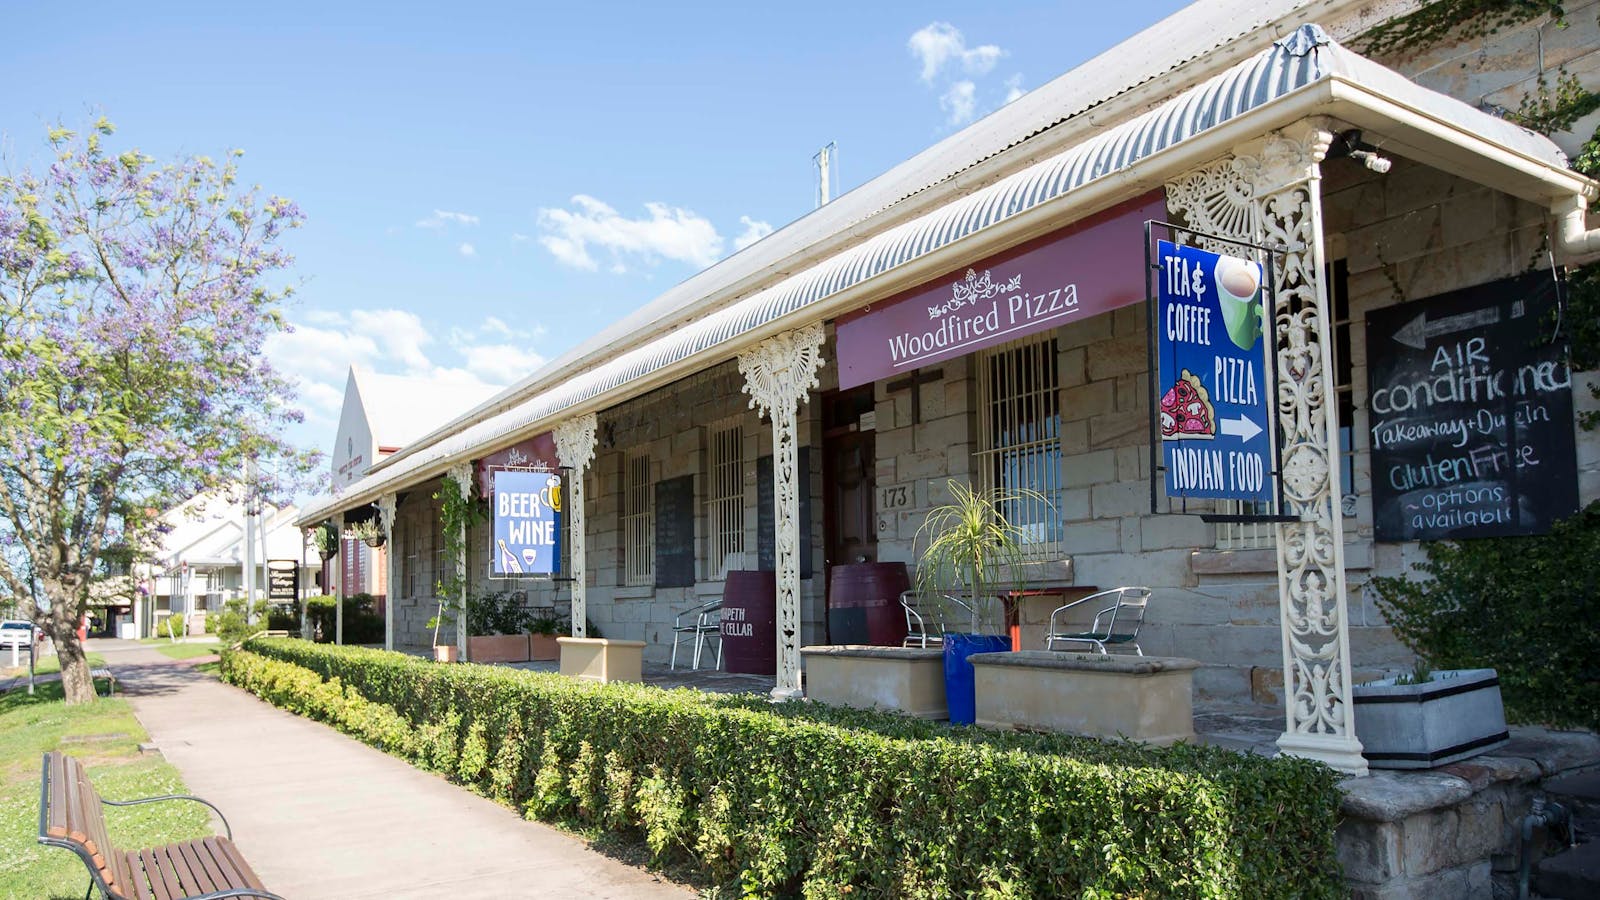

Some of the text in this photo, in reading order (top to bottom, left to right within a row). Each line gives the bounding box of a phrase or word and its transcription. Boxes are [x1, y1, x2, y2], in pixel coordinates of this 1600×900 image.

[889, 283, 1078, 361] Woodfired Pizza
[1166, 303, 1211, 345] COFFEE
[1431, 337, 1490, 371] AIR
[1215, 355, 1257, 405] PIZZA
[1172, 448, 1263, 492] INDIAN FOOD
[1469, 445, 1539, 477] Fre
[499, 492, 541, 518] BEER
[883, 486, 906, 508] 173
[509, 520, 555, 545] WINE
[725, 622, 753, 636] CELLAR
